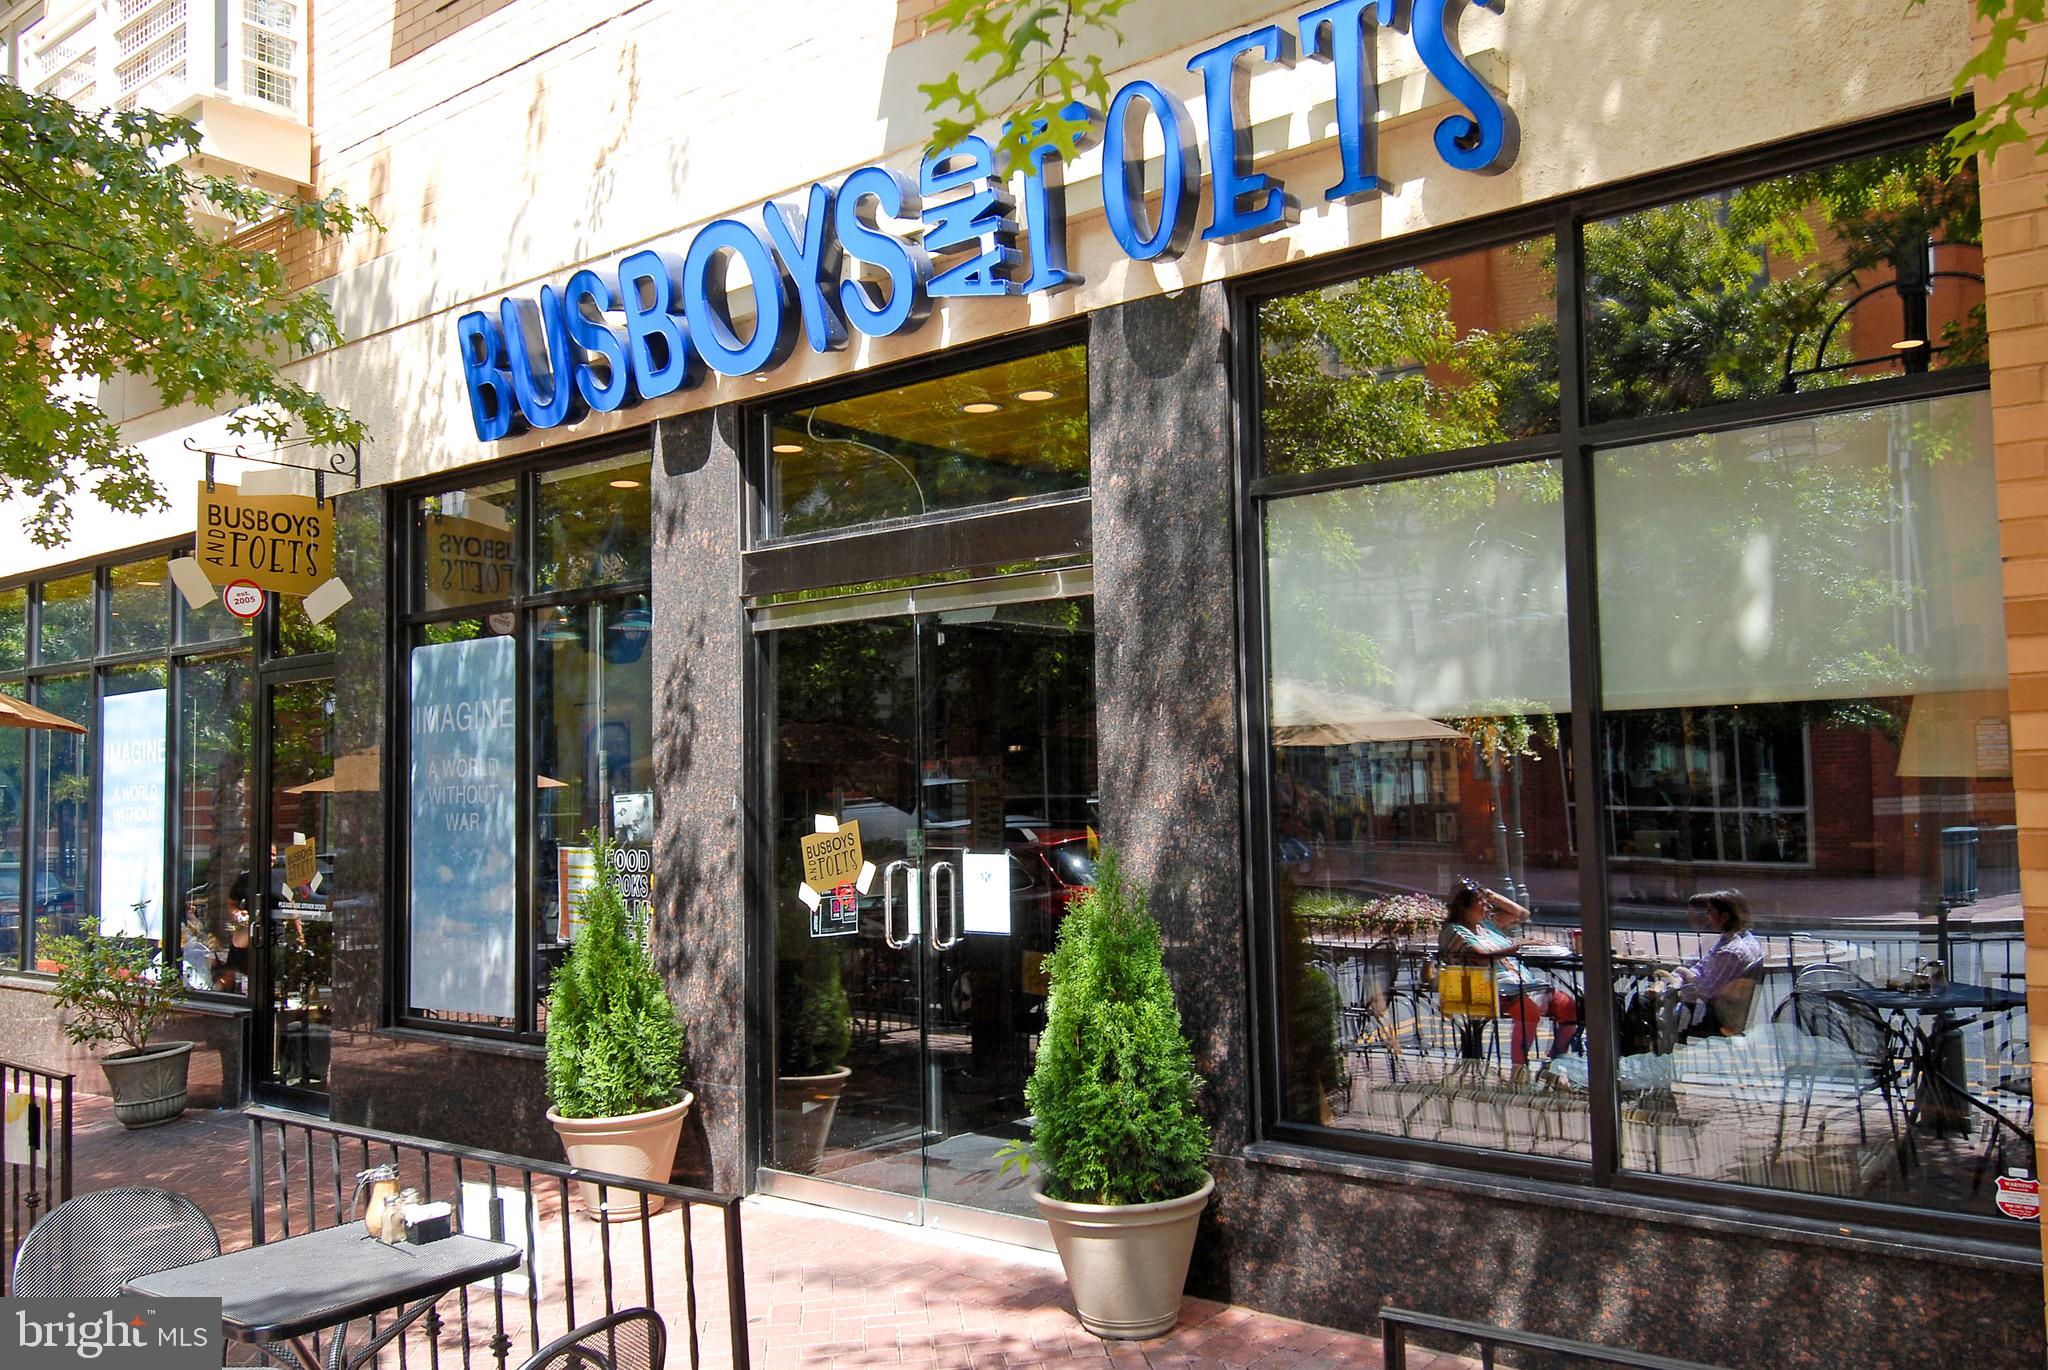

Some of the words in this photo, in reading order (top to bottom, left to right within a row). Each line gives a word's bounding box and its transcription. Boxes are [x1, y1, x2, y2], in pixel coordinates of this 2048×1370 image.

[457, 166, 927, 442] BUSBOYS
[919, 134, 1012, 297] AND
[1002, 0, 1515, 297] POETS
[207, 503, 321, 539] BUSBOYS
[205, 528, 226, 566] AND
[229, 531, 319, 577] POETS
[234, 596, 256, 605] 2005
[415, 697, 513, 735] IMAGINE
[105, 737, 167, 767] IMAGINE
[428, 762, 438, 778] A
[441, 757, 500, 779] WORLD
[112, 787, 119, 802] A
[121, 784, 158, 802] WORLD
[428, 783, 499, 806] WITHOUT
[112, 804, 158, 825] WITHOUT
[445, 812, 480, 832] WAR
[806, 832, 855, 859] BUSBOYS
[809, 860, 817, 880] AND
[817, 848, 858, 880] POETS
